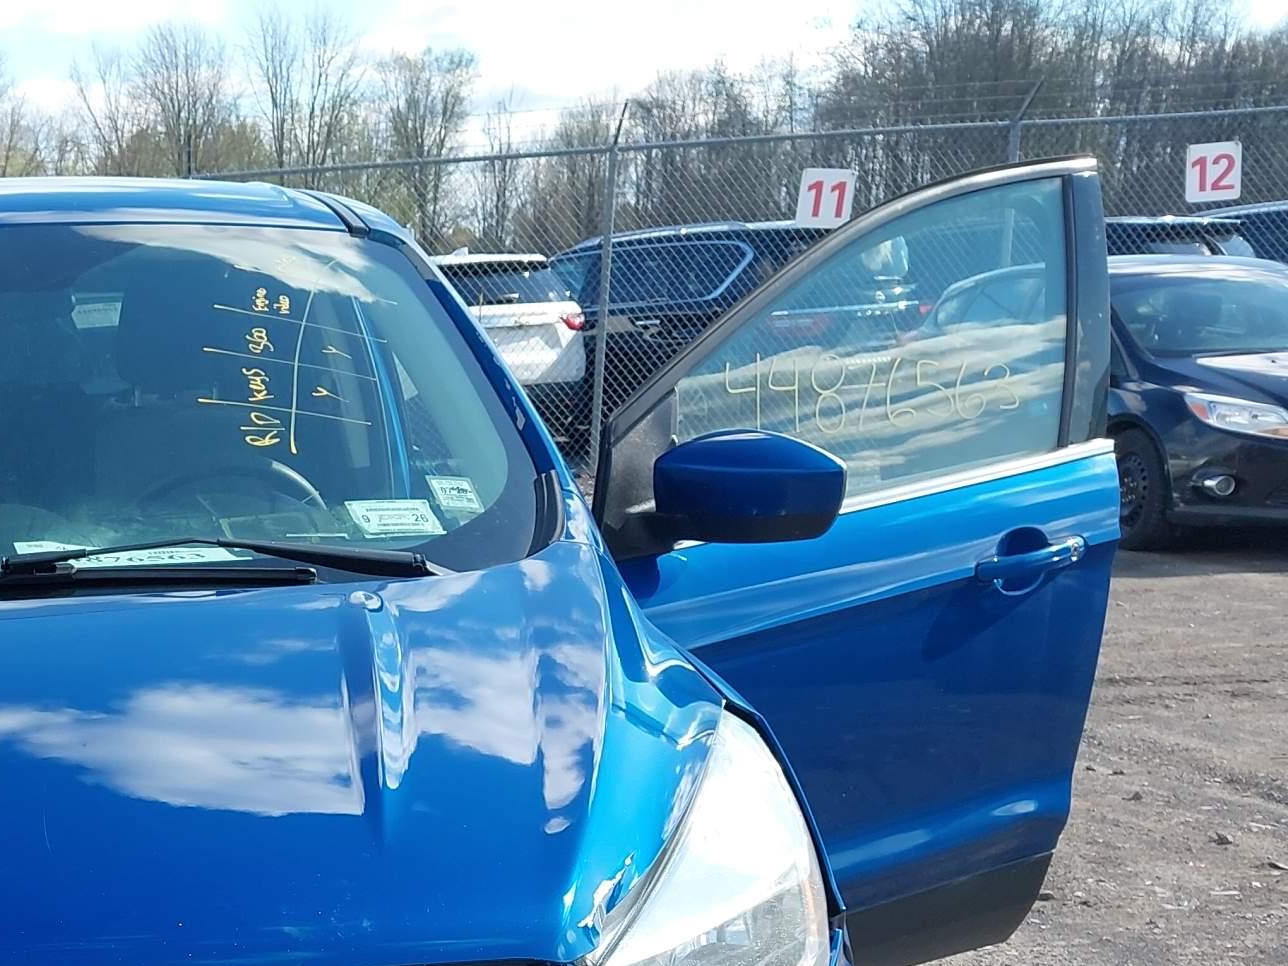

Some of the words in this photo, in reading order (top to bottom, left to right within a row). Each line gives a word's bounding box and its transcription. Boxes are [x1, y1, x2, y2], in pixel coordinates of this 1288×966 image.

[1190, 152, 1236, 193] 12
[807, 180, 848, 219] 11
[245, 327, 274, 354] 360
[724, 352, 1020, 434] 44876563
